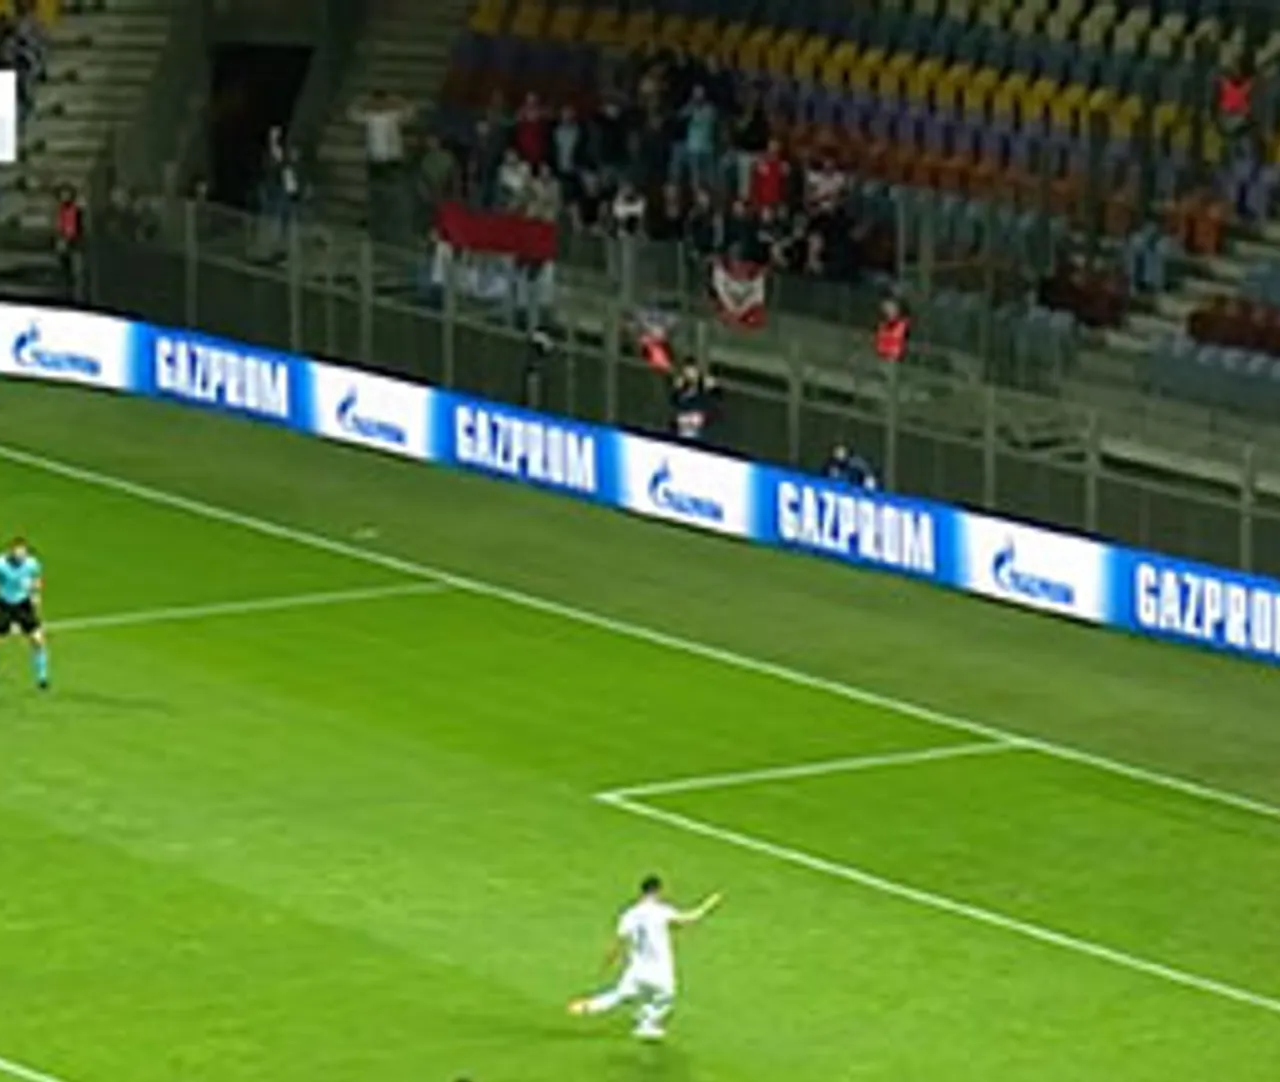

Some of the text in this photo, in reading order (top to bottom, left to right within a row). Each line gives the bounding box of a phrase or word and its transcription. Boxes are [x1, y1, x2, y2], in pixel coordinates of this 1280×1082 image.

[154, 335, 290, 420] GAZPROM
[454, 405, 597, 494] GAZPROM
[776, 479, 936, 575] GAZPROM
